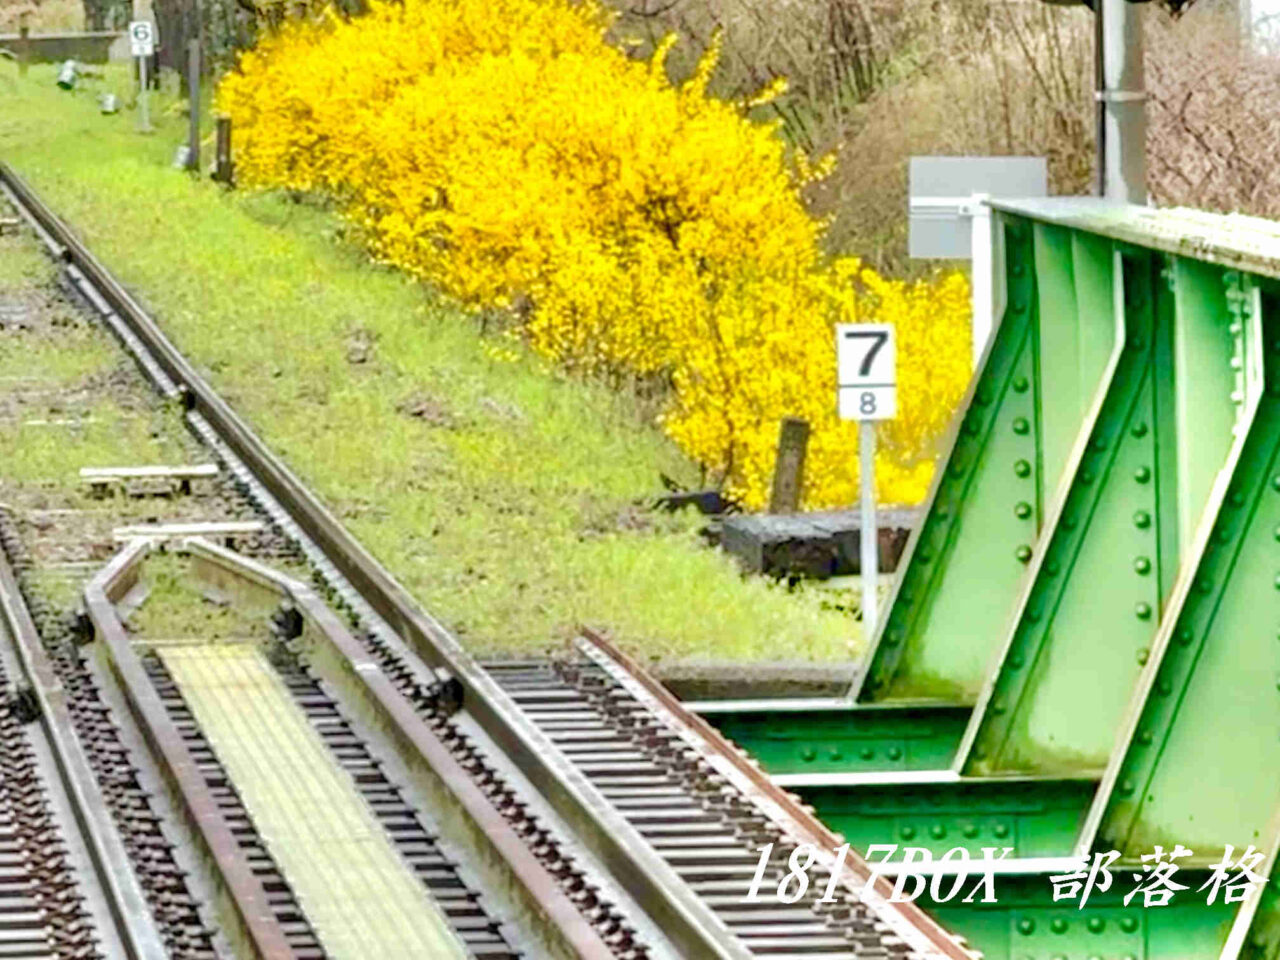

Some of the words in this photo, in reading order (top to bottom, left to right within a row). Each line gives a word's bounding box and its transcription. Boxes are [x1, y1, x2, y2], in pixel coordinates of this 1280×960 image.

[133, 24, 149, 41] 6
[845, 331, 888, 376] 7
[860, 392, 876, 414] 8
